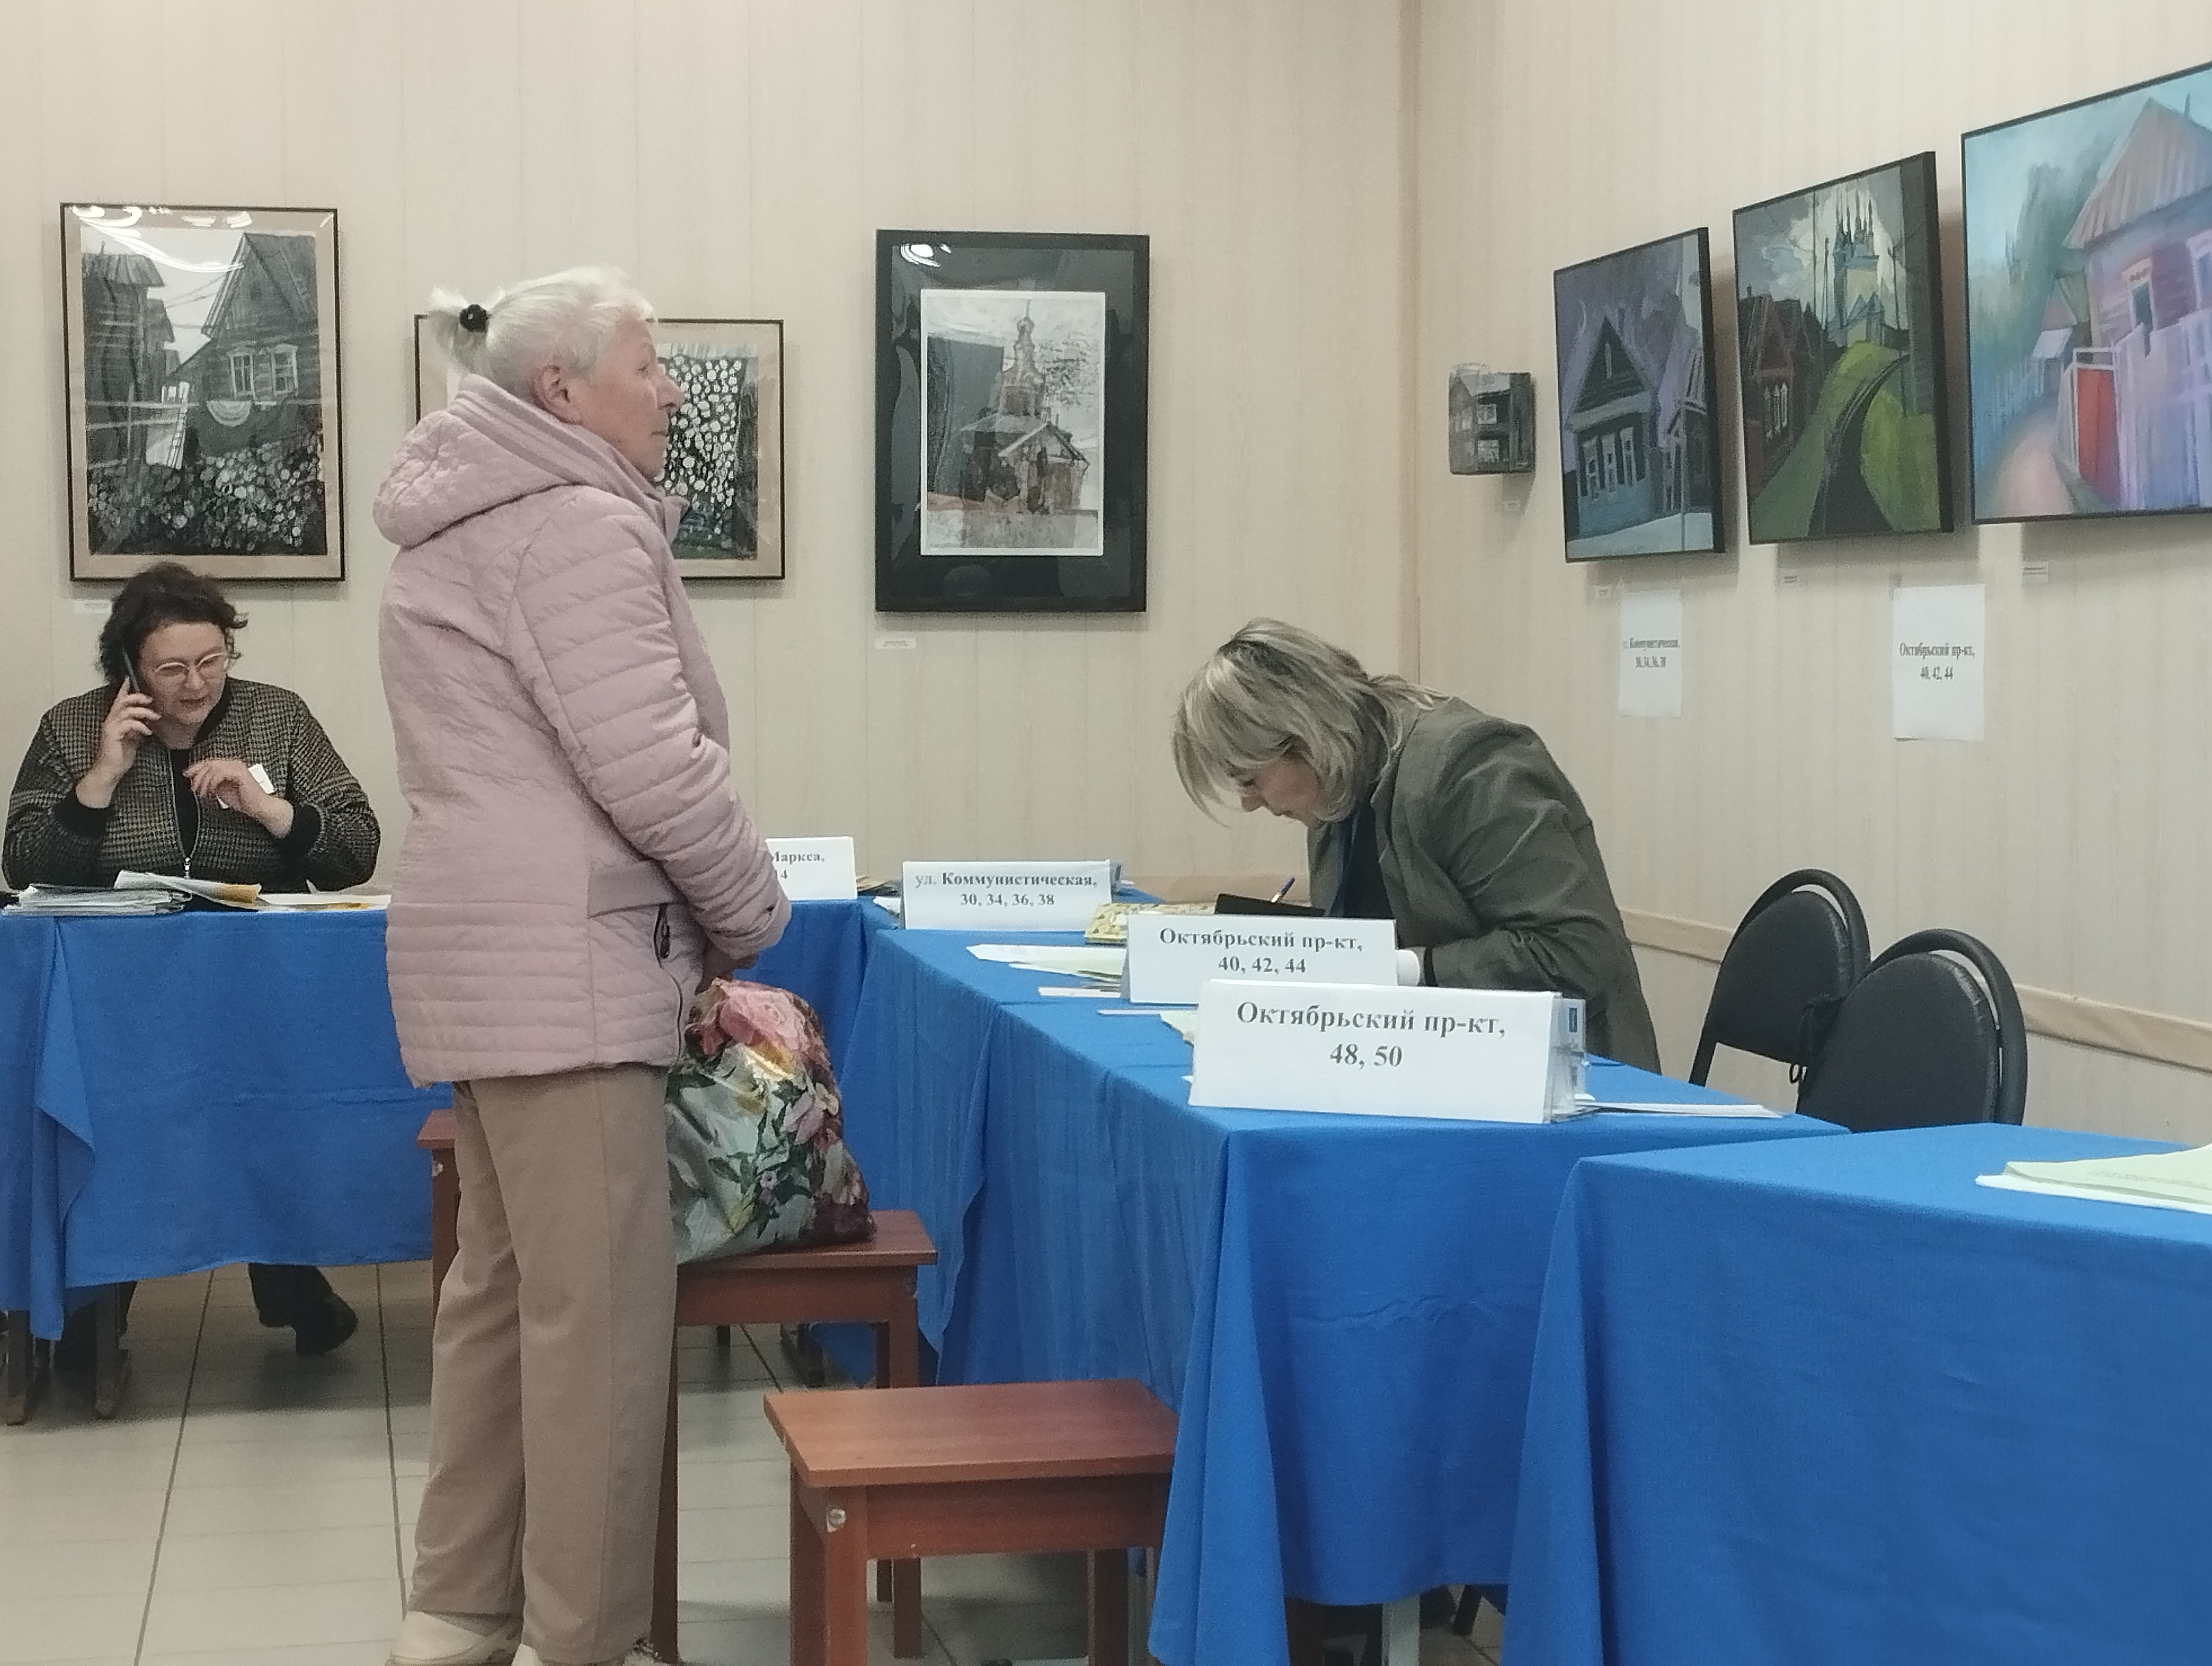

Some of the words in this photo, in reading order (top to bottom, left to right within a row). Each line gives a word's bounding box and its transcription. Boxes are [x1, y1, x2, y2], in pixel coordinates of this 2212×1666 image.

[915, 875, 937, 888] ул.
[943, 872, 1097, 889] Коммунистическая,
[986, 893, 1008, 907] 34,
[1038, 894, 1054, 905] 38
[1160, 928, 1295, 950] Октябрьский
[1302, 937, 1362, 952] пр-кт,
[1218, 956, 1245, 974] 40,
[1252, 957, 1279, 976] 42,
[1284, 958, 1306, 973] 44
[1237, 1002, 1415, 1032] Октябрьский
[1424, 1016, 1505, 1039] пр-кт,
[1329, 1044, 1365, 1069] 48,
[1374, 1046, 1402, 1067] 50
